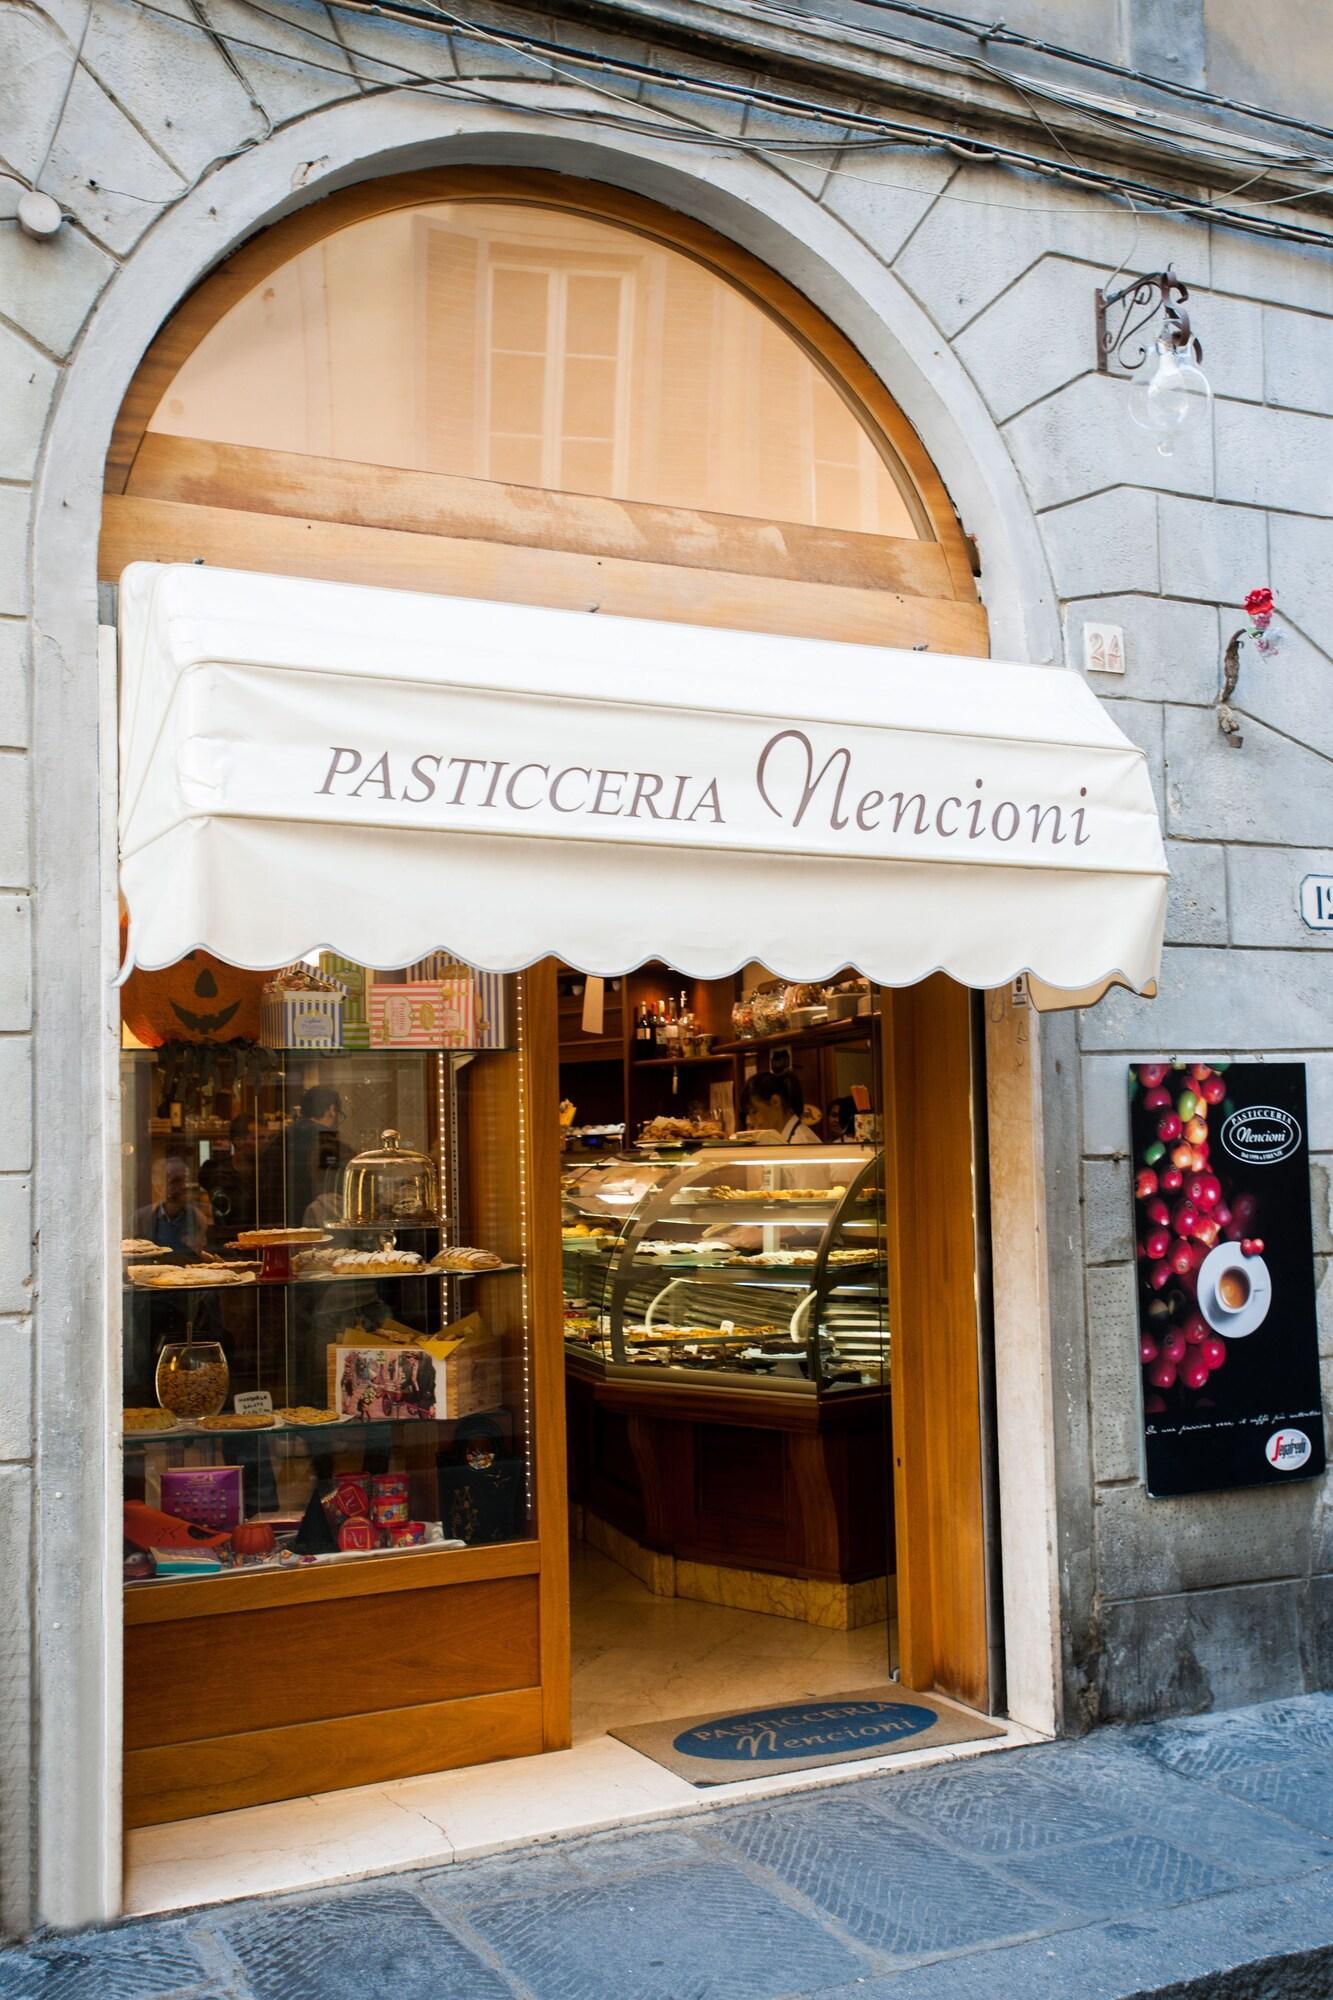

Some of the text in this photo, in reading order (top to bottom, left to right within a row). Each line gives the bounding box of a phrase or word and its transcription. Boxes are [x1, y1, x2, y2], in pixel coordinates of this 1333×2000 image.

[1088, 632, 1121, 662] 24
[314, 729, 1090, 845] PASTICCERIA Nencioni
[1231, 1109, 1292, 1125] PASTICCERIA
[1236, 1126, 1286, 1143] Nencioni
[693, 1702, 898, 1742] PASTICCERIA
[735, 1718, 917, 1758] Nencioni
